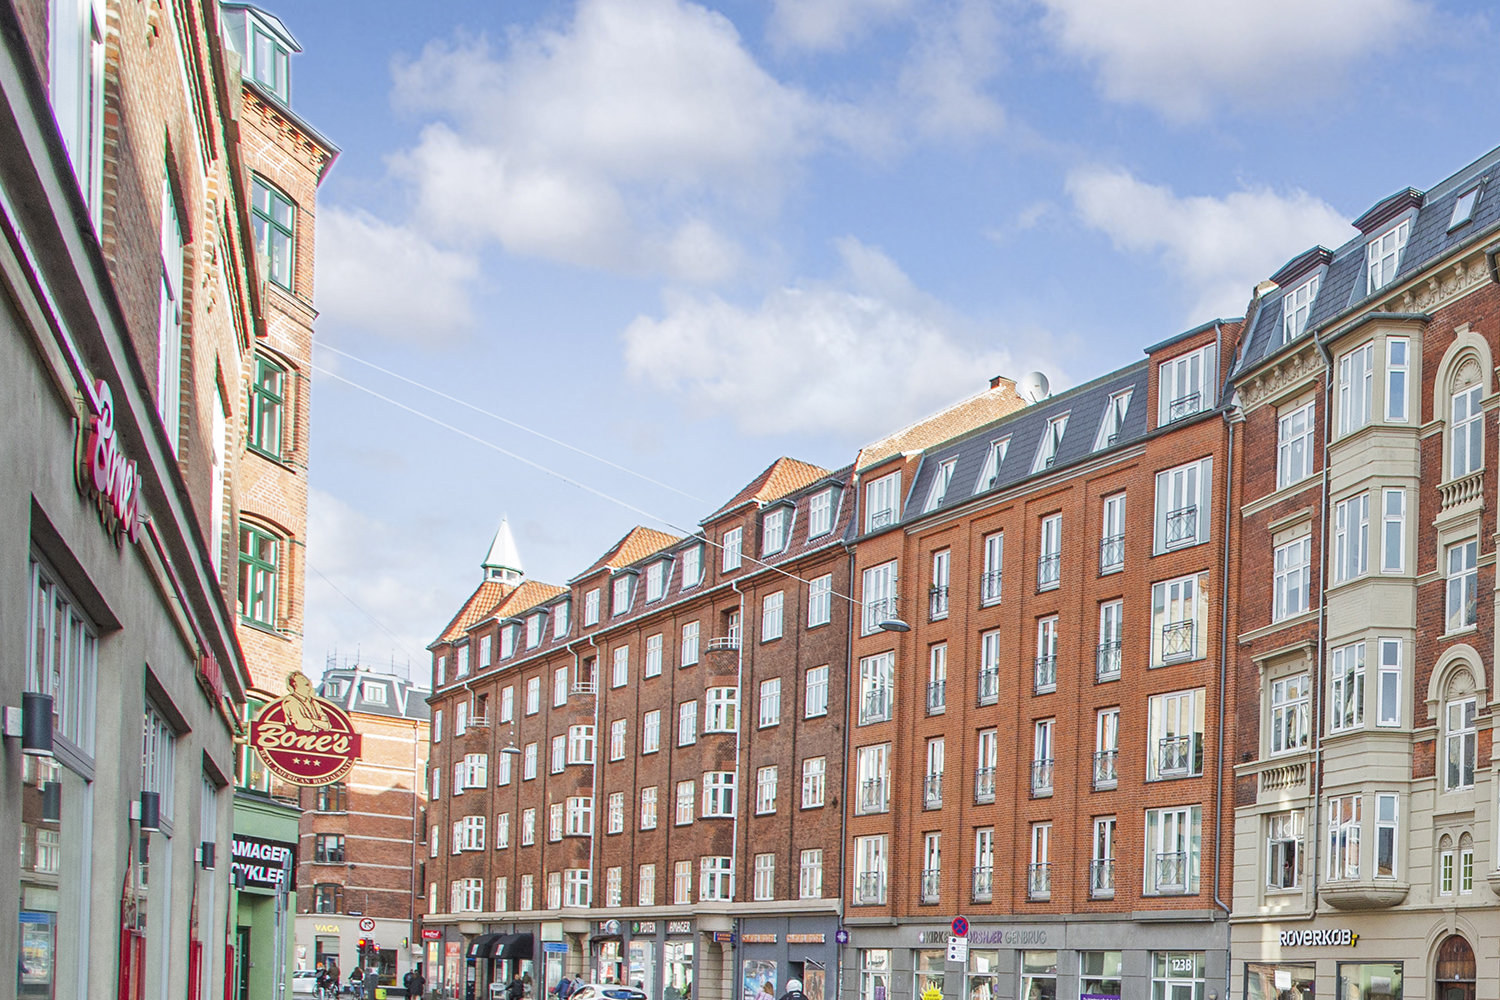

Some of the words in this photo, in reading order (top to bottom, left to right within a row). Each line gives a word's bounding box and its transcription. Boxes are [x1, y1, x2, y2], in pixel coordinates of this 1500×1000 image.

[257, 723, 351, 754] Bone's
[273, 766, 312, 784] AMERICAN
[314, 924, 340, 933] VACA
[1005, 931, 1047, 945] GENBRUG
[1171, 958, 1192, 972] 123B
